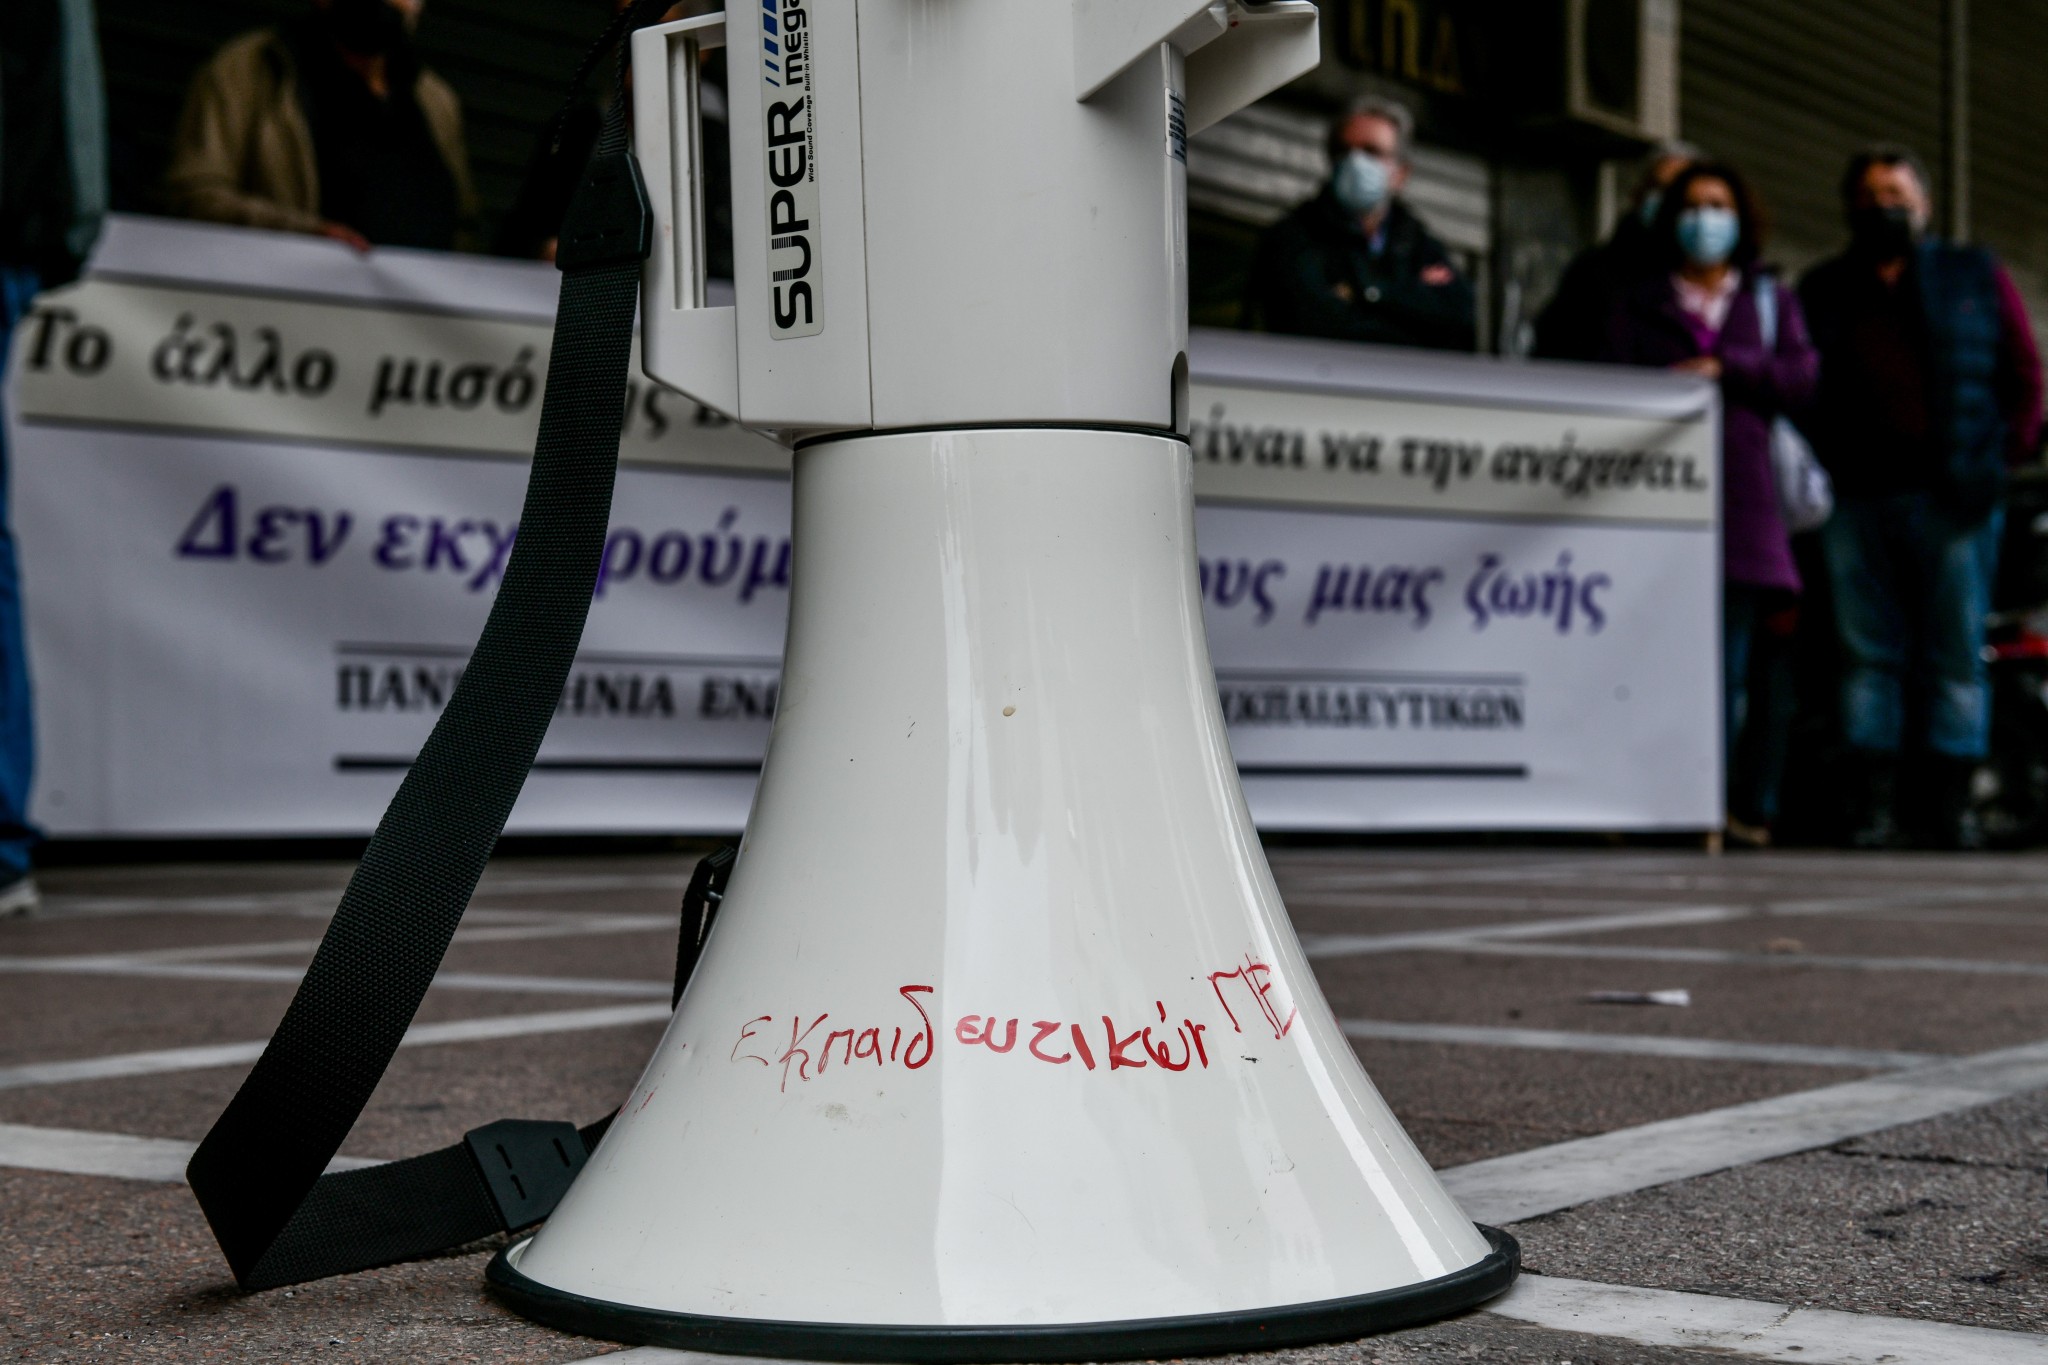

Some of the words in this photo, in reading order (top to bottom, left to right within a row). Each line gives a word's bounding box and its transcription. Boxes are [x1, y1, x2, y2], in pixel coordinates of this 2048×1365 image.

[766, 95, 813, 330] SUPER
[806, 135, 814, 160] Sound
[28, 309, 110, 376] Το
[151, 314, 335, 397] άλλο
[1317, 430, 1384, 473] να
[1398, 433, 1482, 492] την
[175, 484, 352, 566] Δεν
[1304, 562, 1444, 630] μιας
[1463, 549, 1612, 635] ζωής
